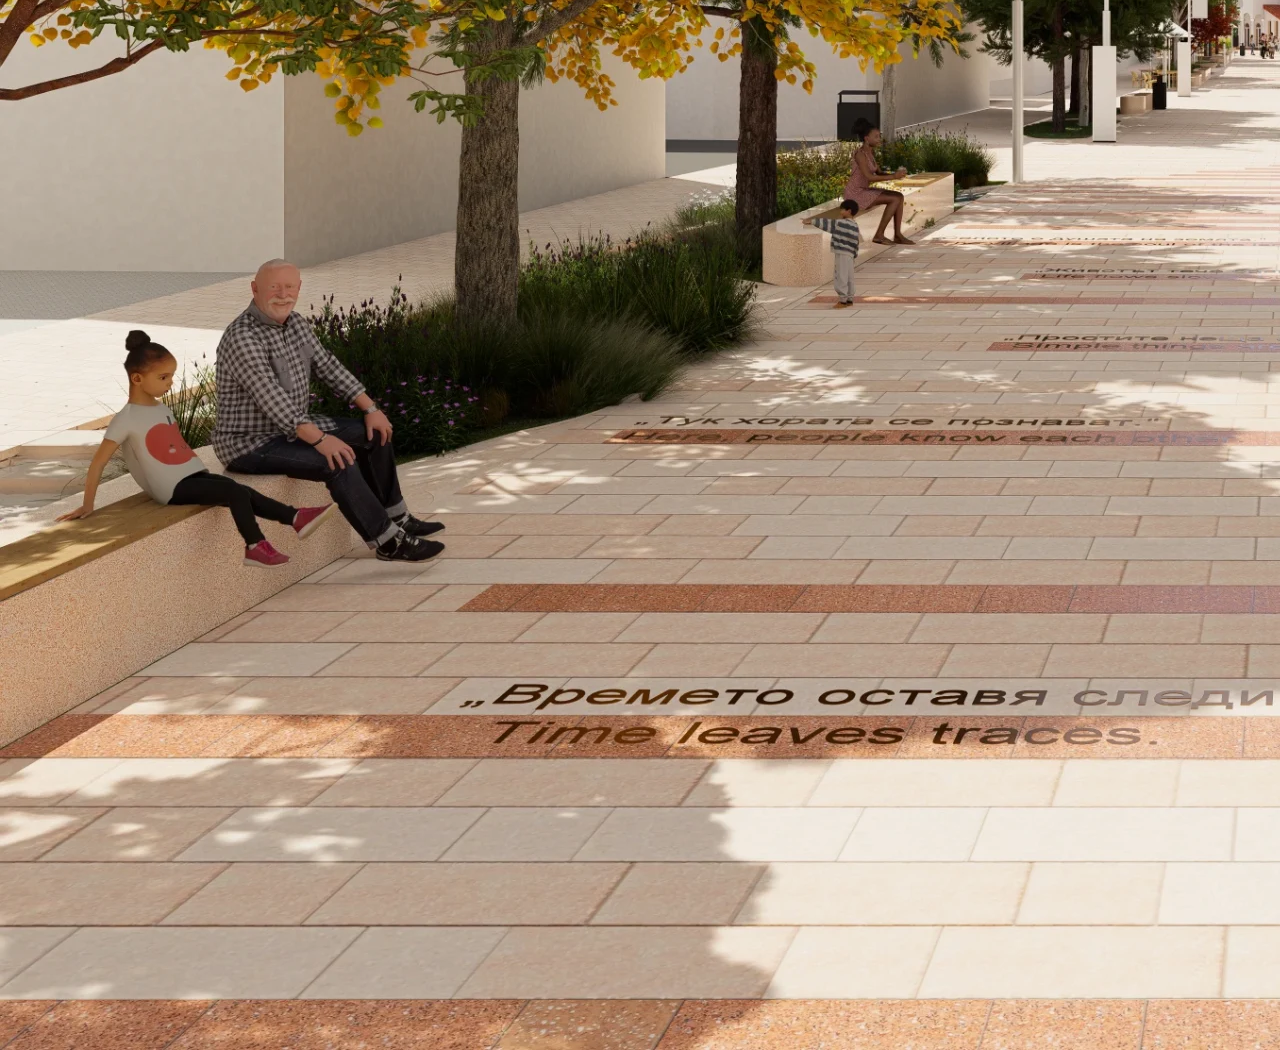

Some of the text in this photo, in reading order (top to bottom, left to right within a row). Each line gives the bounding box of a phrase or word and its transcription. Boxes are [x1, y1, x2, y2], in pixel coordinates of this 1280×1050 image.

[1013, 342, 1121, 351] Simple
[1132, 342, 1224, 351] things
[731, 418, 874, 426] хората
[888, 418, 934, 426] се
[621, 431, 729, 442] Here,
[745, 432, 886, 444] people
[899, 433, 1008, 442] know
[1018, 433, 1116, 443] each
[817, 689, 1048, 706] оставя
[493, 720, 1158, 746] Time leaves traces.
